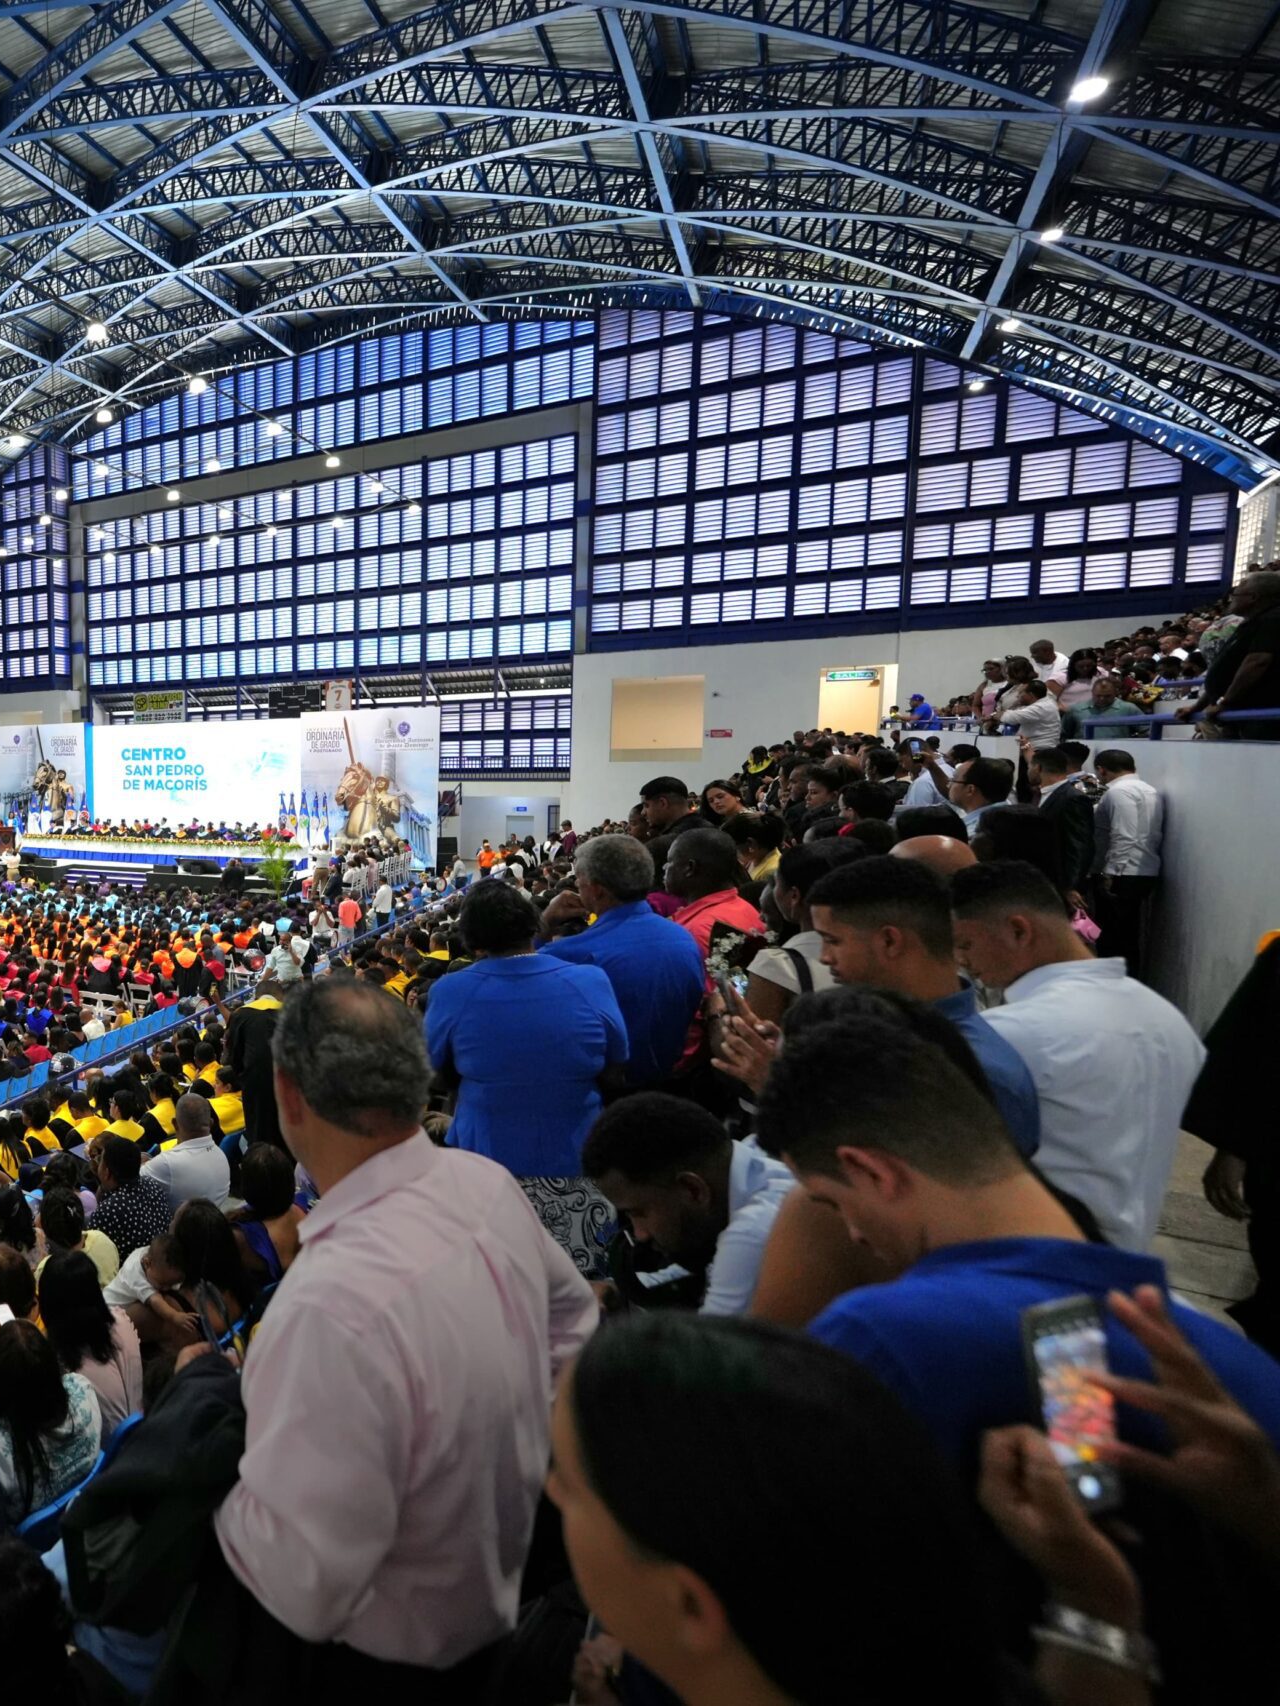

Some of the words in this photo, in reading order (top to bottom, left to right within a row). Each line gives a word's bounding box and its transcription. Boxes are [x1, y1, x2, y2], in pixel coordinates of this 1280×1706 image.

[334, 689, 342, 701] 7
[306, 731, 345, 741] ORDINARIA
[311, 741, 319, 749] DE
[320, 741, 340, 749] GRADO
[121, 747, 186, 761] CENTRO
[125, 764, 152, 776] SAN
[156, 764, 204, 776] PEDRO
[123, 779, 141, 790] DE
[144, 776, 208, 791] MACORÍS
